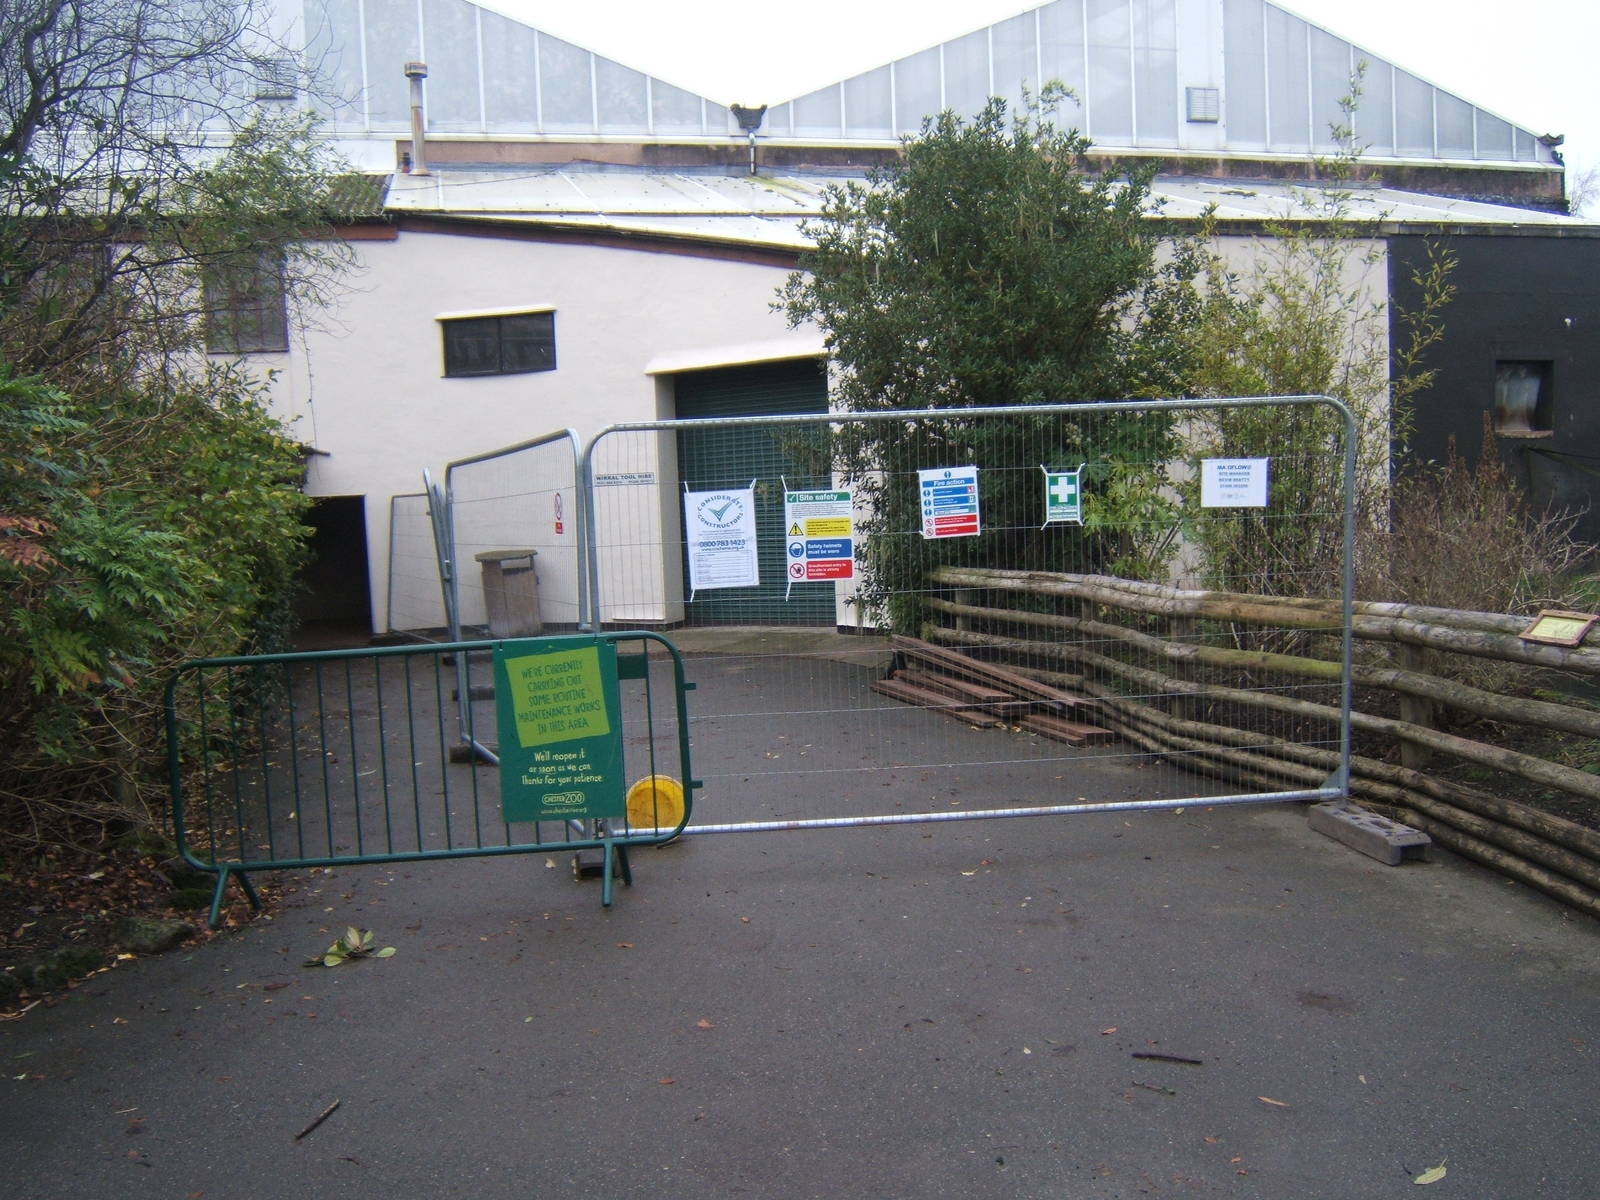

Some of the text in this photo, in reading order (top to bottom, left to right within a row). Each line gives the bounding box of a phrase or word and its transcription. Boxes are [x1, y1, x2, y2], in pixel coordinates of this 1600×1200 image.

[697, 495, 743, 512] CONSIDERATE
[815, 493, 838, 501] safety
[697, 512, 744, 529] CONSTRUCTORS
[544, 660, 583, 675] CURRENTLY
[527, 675, 582, 692] CARRYING OUT
[528, 688, 587, 707] SOME ROUTINE
[518, 699, 601, 721] MAINTENANCE WORKS
[537, 717, 590, 735] IN THIS AREA
[552, 753, 577, 763] reopen
[579, 747, 585, 759] it
[539, 766, 556, 774] soon
[521, 775, 543, 785] Thanks
[544, 775, 556, 784] for
[557, 776, 572, 786] your
